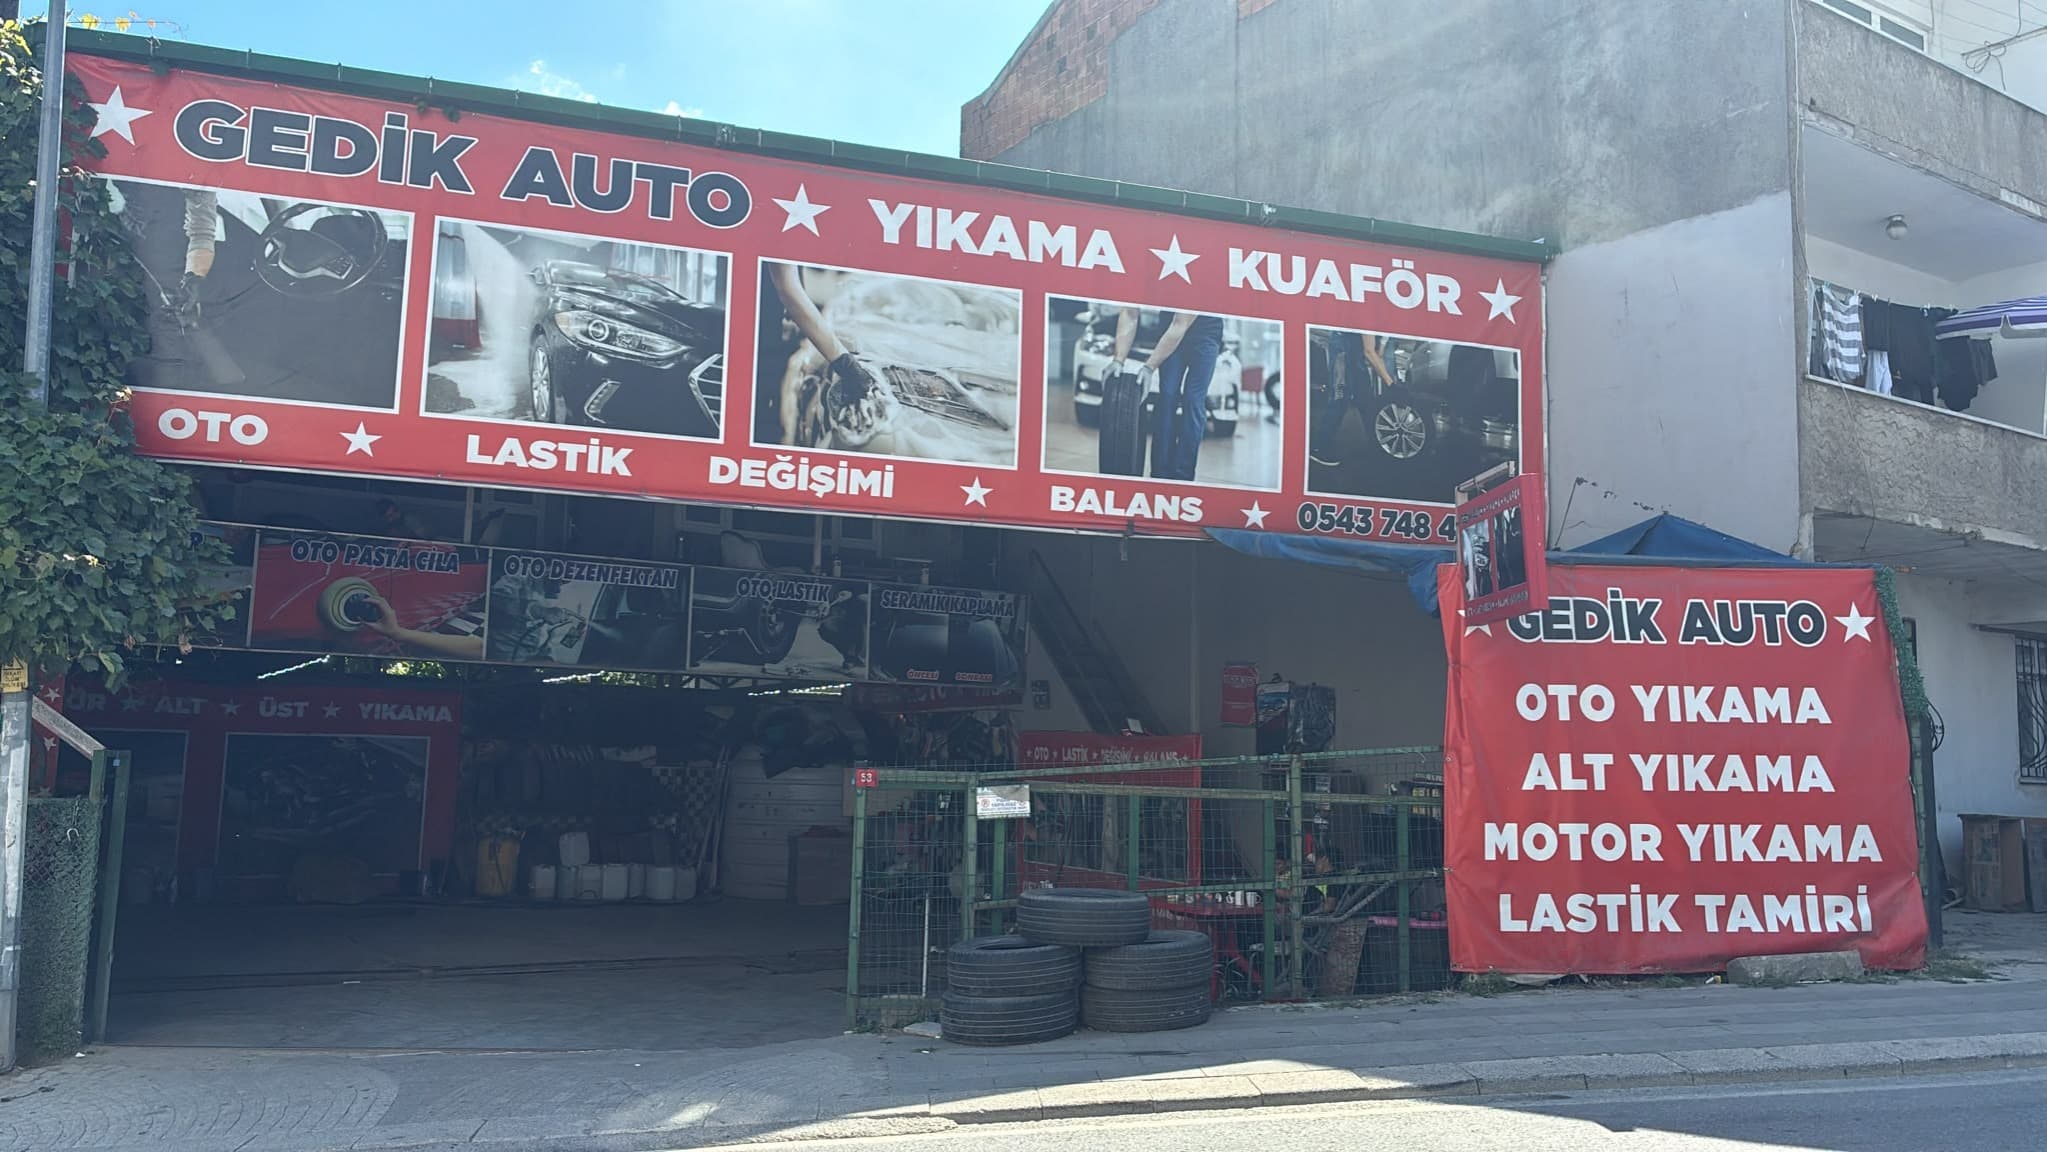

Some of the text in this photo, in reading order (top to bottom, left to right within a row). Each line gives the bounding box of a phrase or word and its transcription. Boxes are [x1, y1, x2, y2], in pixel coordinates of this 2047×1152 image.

[173, 99, 1463, 316] GEDİK AUTO YIKAMA KUAFÖR
[158, 408, 1204, 523] OTO LASTİK DEĞİŞİMİ BALANS
[1297, 501, 1374, 536] 0543
[1379, 507, 1432, 540] 748
[291, 539, 340, 564] OTO
[343, 543, 410, 570] PASTA
[504, 554, 678, 589] OTO DEZENFEKTAN
[736, 577, 773, 599] OTO
[947, 594, 1014, 618] KAPLAMA
[1506, 588, 1667, 644] GEDİK
[1679, 599, 1827, 646] AUTO
[154, 696, 208, 715] ALT
[258, 697, 310, 719] ÜST
[358, 702, 453, 722] YIKAMA
[1515, 683, 1832, 724] OTO YIKAMA
[1034, 746, 1049, 761] OTO
[1522, 753, 1836, 793] ALT YIKAMA
[860, 772, 873, 783] 53
[1484, 822, 1883, 863] MOTOR YIKAMA
[1499, 884, 1873, 933] LASTİK TAMİRİ
